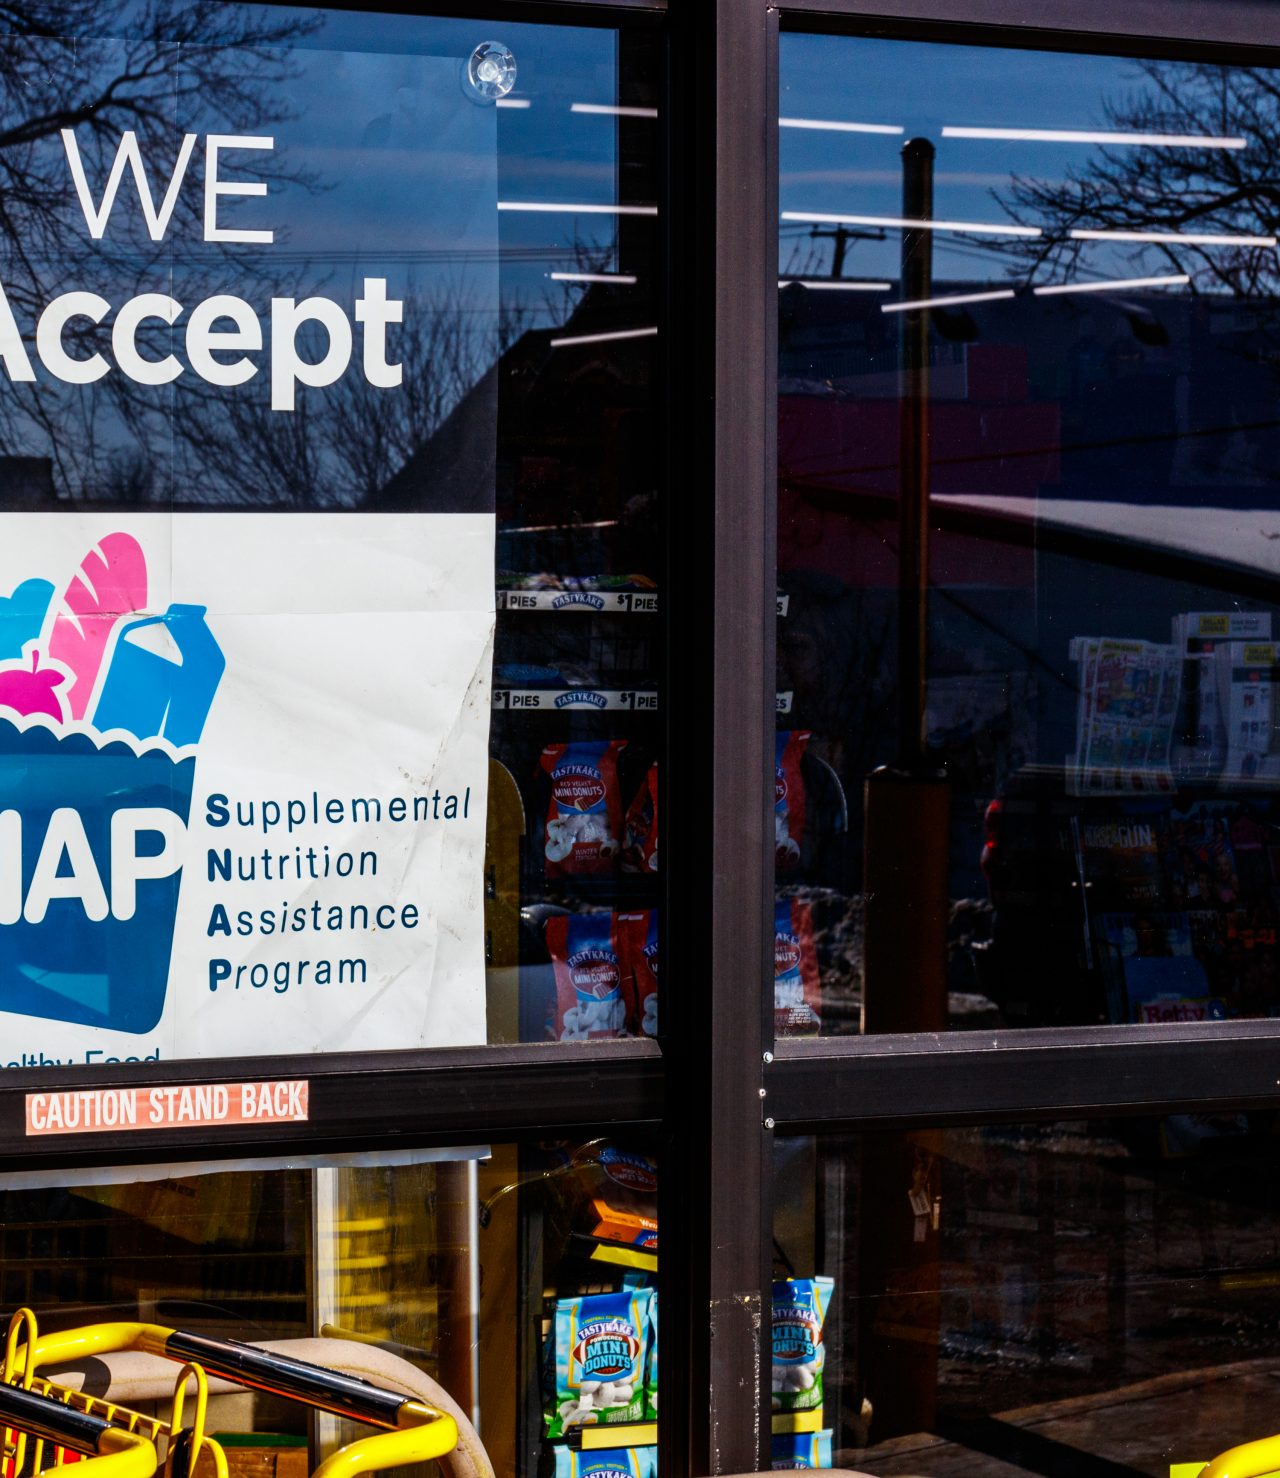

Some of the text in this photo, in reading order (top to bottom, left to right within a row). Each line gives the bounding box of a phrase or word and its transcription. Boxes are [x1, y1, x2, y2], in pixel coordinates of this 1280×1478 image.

[60, 128, 274, 244] WE
[510, 596, 537, 607] PIES
[553, 594, 603, 609] TASTYKAKE
[617, 594, 633, 611] $1
[494, 691, 540, 709] $1 PIES
[556, 692, 606, 708] TASTYKAKE
[620, 692, 636, 709] $1
[550, 765, 601, 779] TASTYKAKE
[573, 785, 603, 796] DONUTS
[205, 786, 471, 834] Supplemental
[207, 844, 378, 882] Nutrition
[206, 899, 420, 937] Assistance
[567, 950, 618, 968] TASTYKAKE
[208, 957, 368, 993] Program
[30, 1081, 304, 1130] CAUTION STAND BACK
[578, 1322, 633, 1340] TASTYKAKE
[586, 1341, 629, 1358] MINI
[585, 1354, 632, 1374] DONUTS
